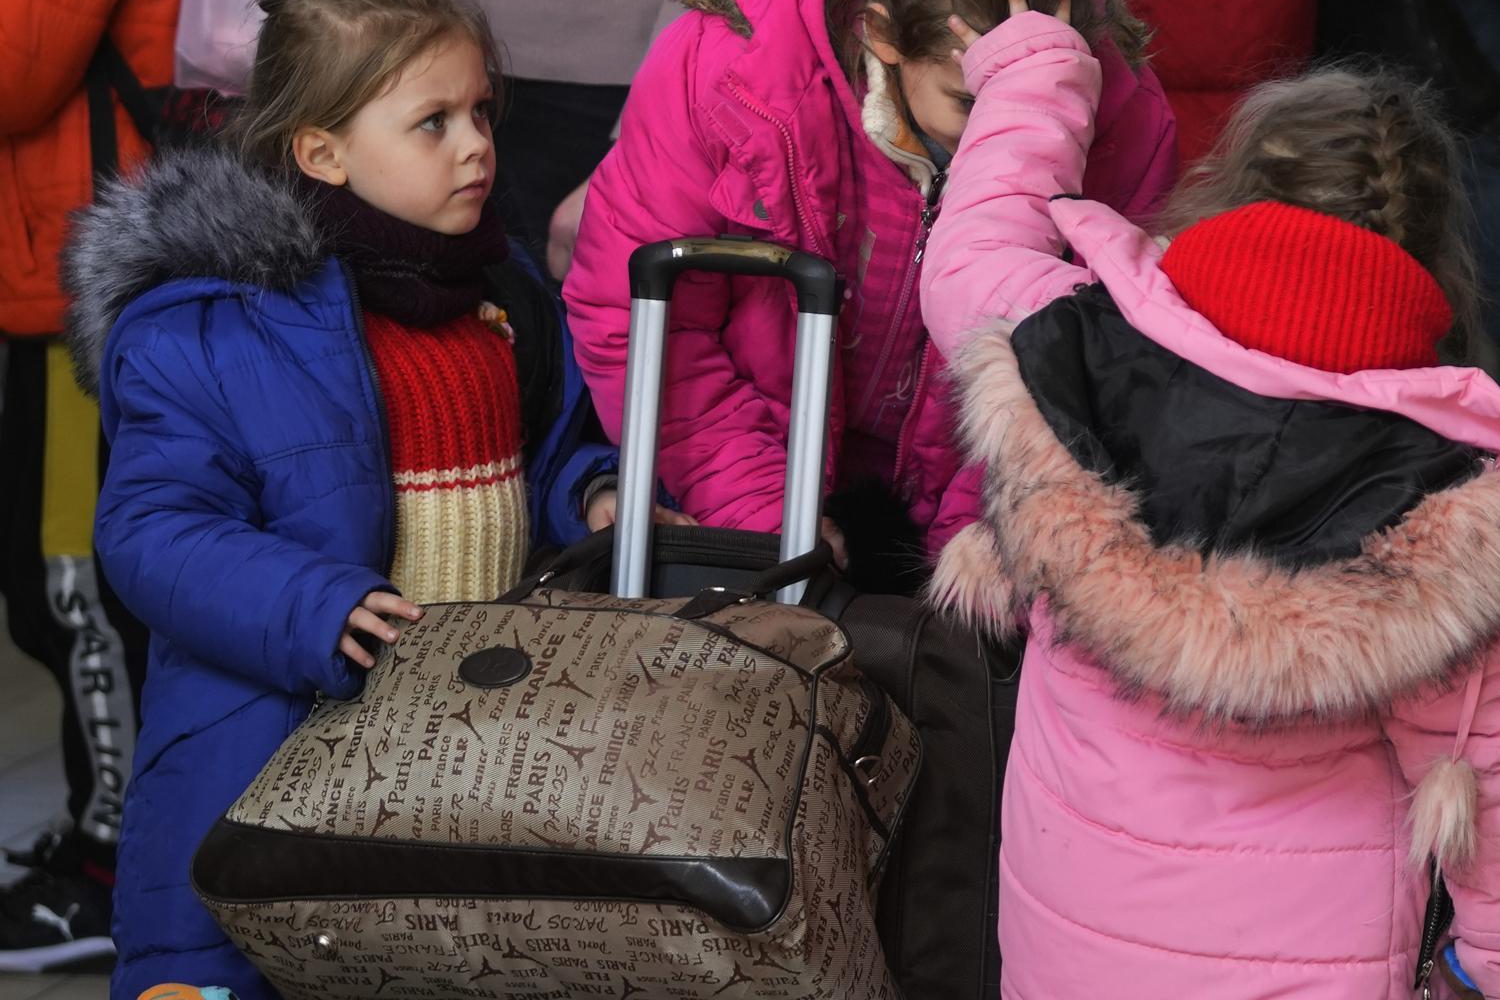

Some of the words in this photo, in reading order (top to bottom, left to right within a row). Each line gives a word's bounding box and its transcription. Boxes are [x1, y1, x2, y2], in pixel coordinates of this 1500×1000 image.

[410, 640, 433, 675] PARIS
[515, 633, 566, 720] FRANCE
[671, 651, 692, 679] FLR
[418, 700, 448, 761] PARIS
[556, 701, 577, 737] FLR
[763, 700, 781, 727] FLR
[281, 746, 315, 802] PARIS
[452, 737, 468, 776] FLR
[694, 735, 728, 792] PARIS
[387, 750, 415, 804] Paris
[522, 751, 552, 814] PARIS
[325, 777, 345, 833] ANCE
[735, 780, 755, 814] FLR
[411, 795, 426, 839] aris
[586, 793, 605, 847] ANCE
[687, 823, 702, 852] ris
[405, 914, 458, 931] PARIS
[648, 918, 710, 937] PARIS
[525, 938, 570, 952] PARIS
